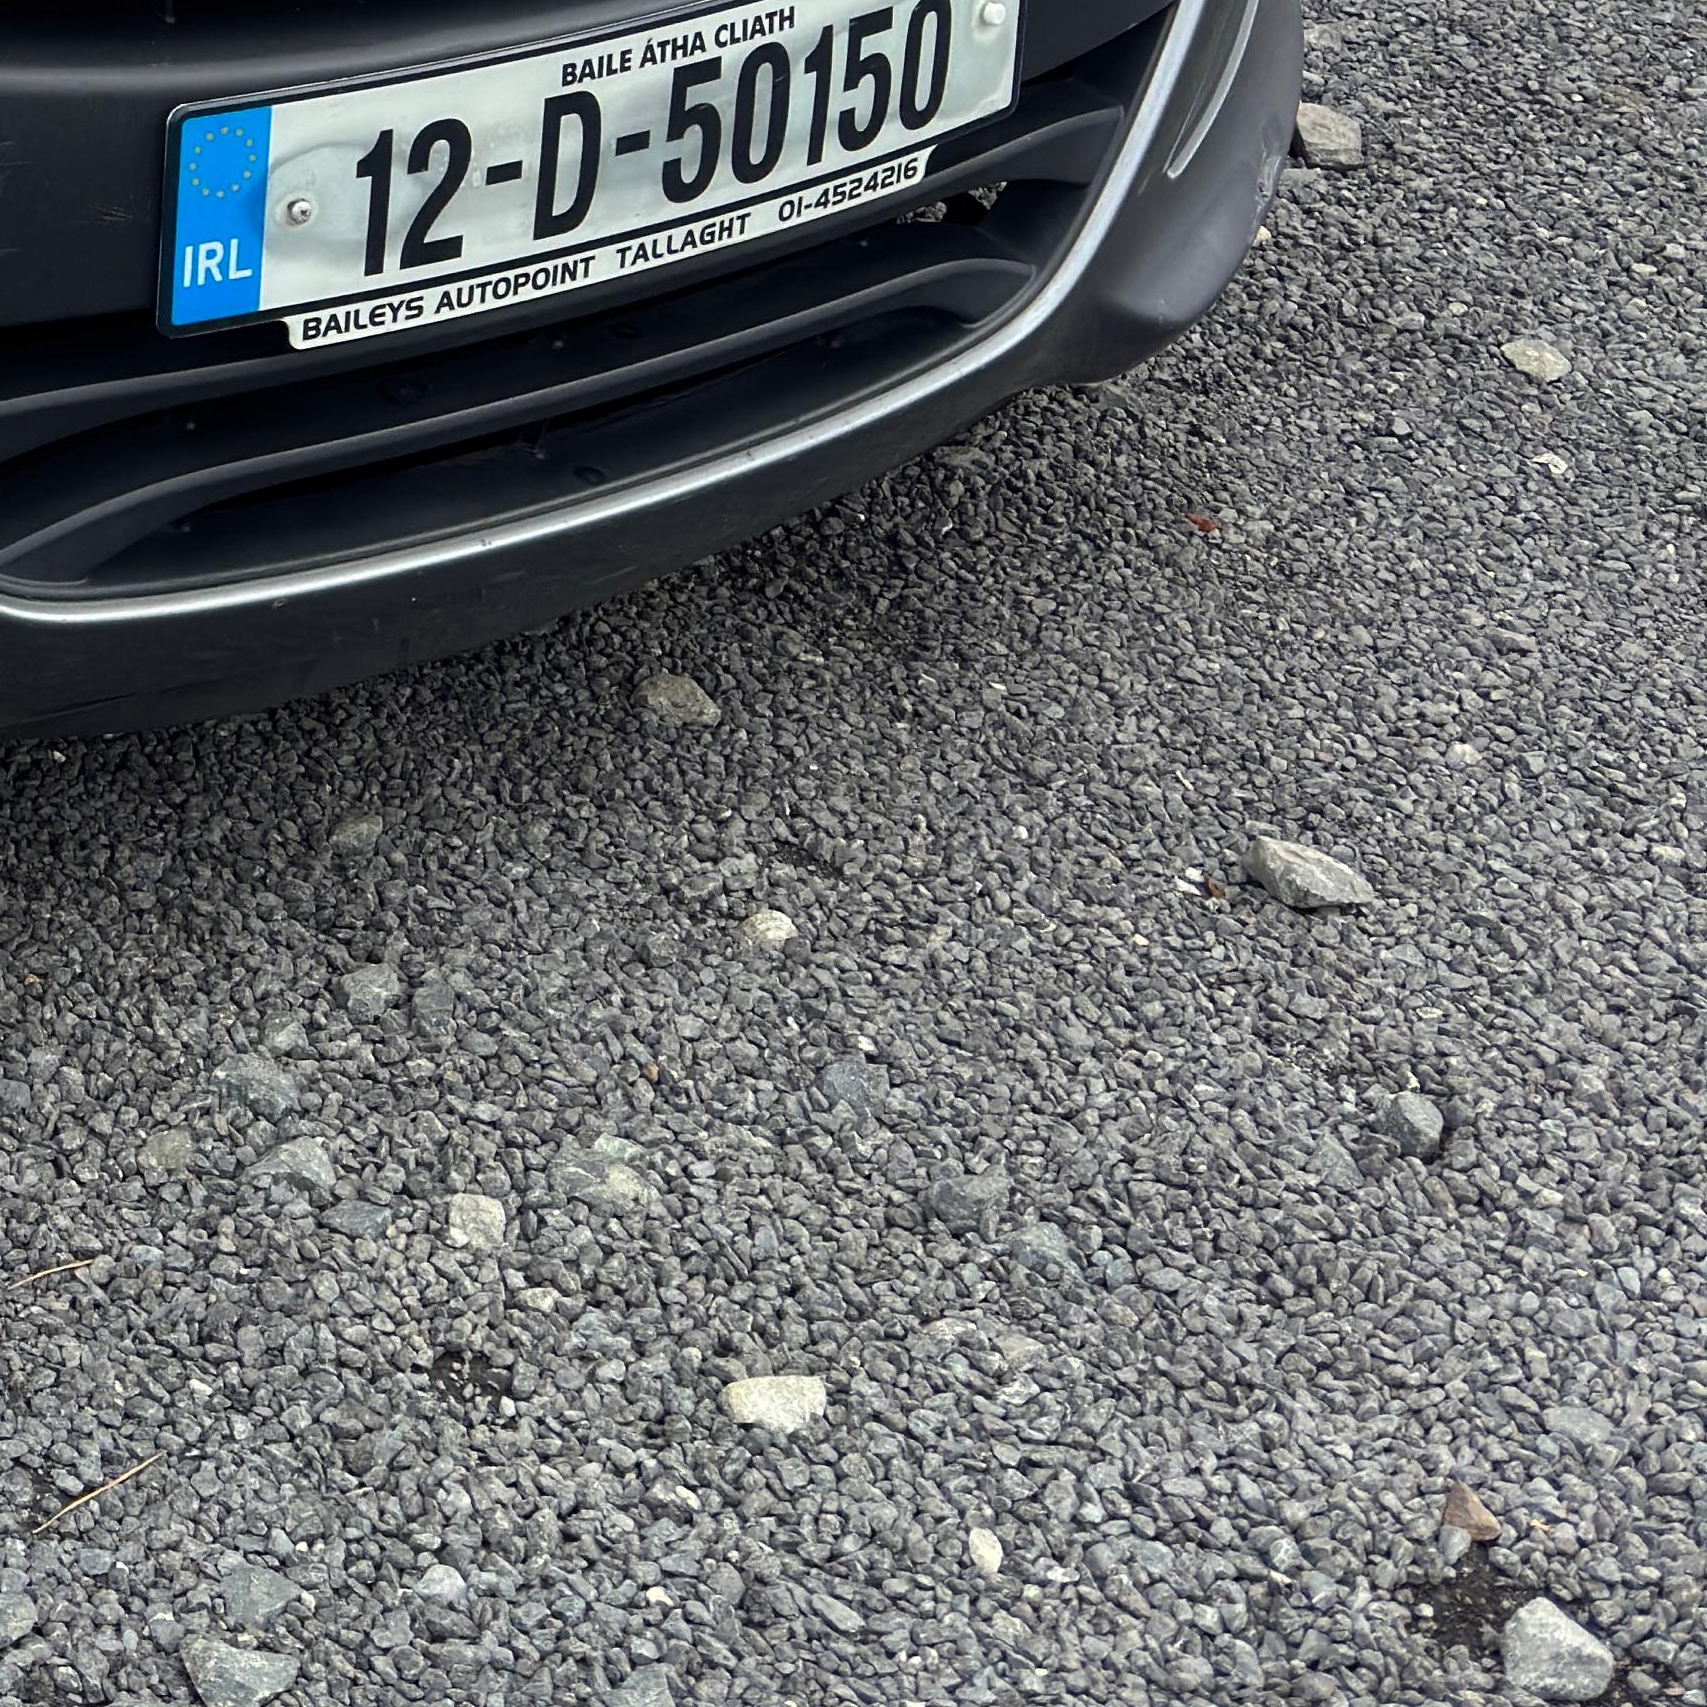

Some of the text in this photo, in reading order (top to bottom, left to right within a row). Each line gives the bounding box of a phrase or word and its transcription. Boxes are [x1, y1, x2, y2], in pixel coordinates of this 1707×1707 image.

[561, 6, 796, 87] BAILE ÁTHA CLIATH
[183, 238, 253, 287] IRL
[302, 157, 918, 341] BAILEYS AUTOPOINT TALLAGHT 01-4524216
